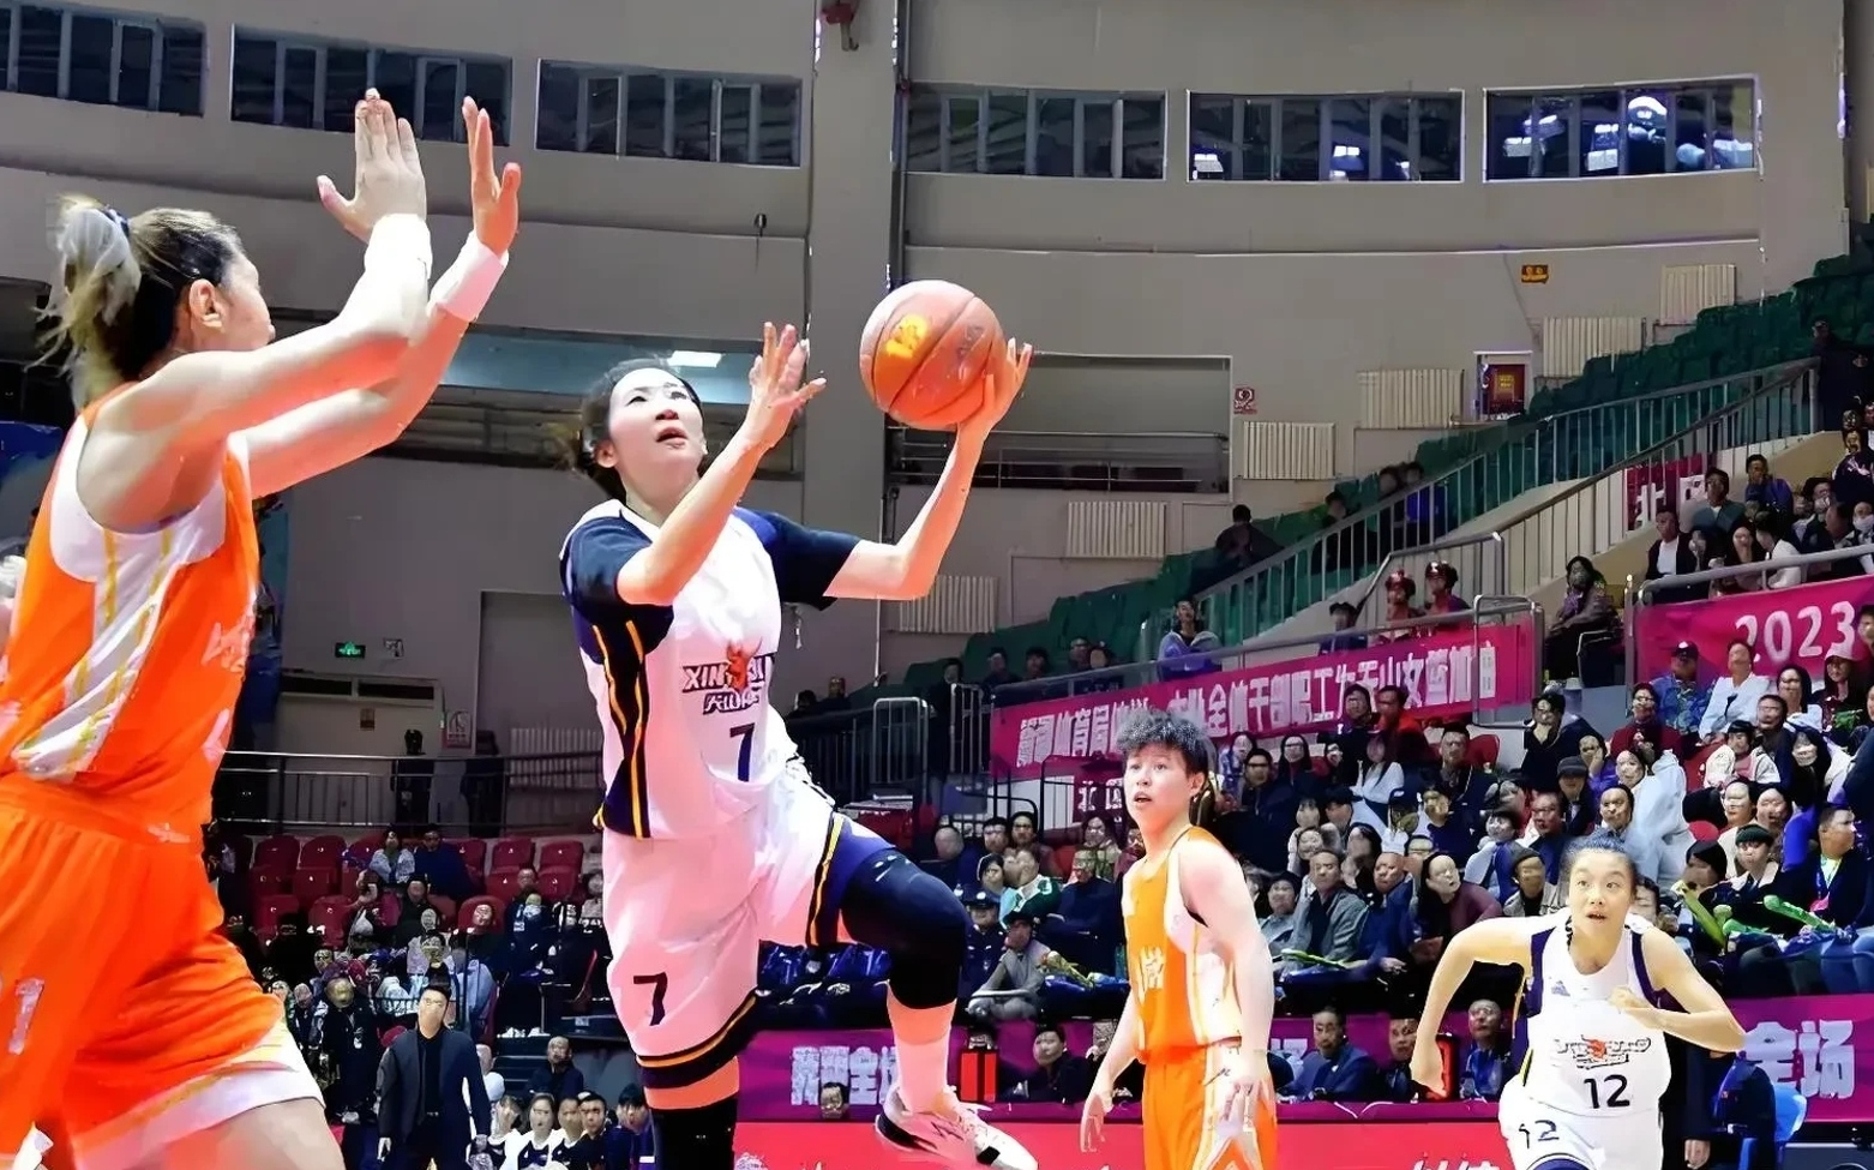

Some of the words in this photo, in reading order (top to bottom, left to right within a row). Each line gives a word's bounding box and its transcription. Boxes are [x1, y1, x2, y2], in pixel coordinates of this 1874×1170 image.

[1735, 601, 1856, 664] 2023
[729, 722, 755, 782] 7
[633, 972, 668, 1026] 7
[1583, 1074, 1631, 1110] 12
[1518, 1119, 1560, 1149] 12
